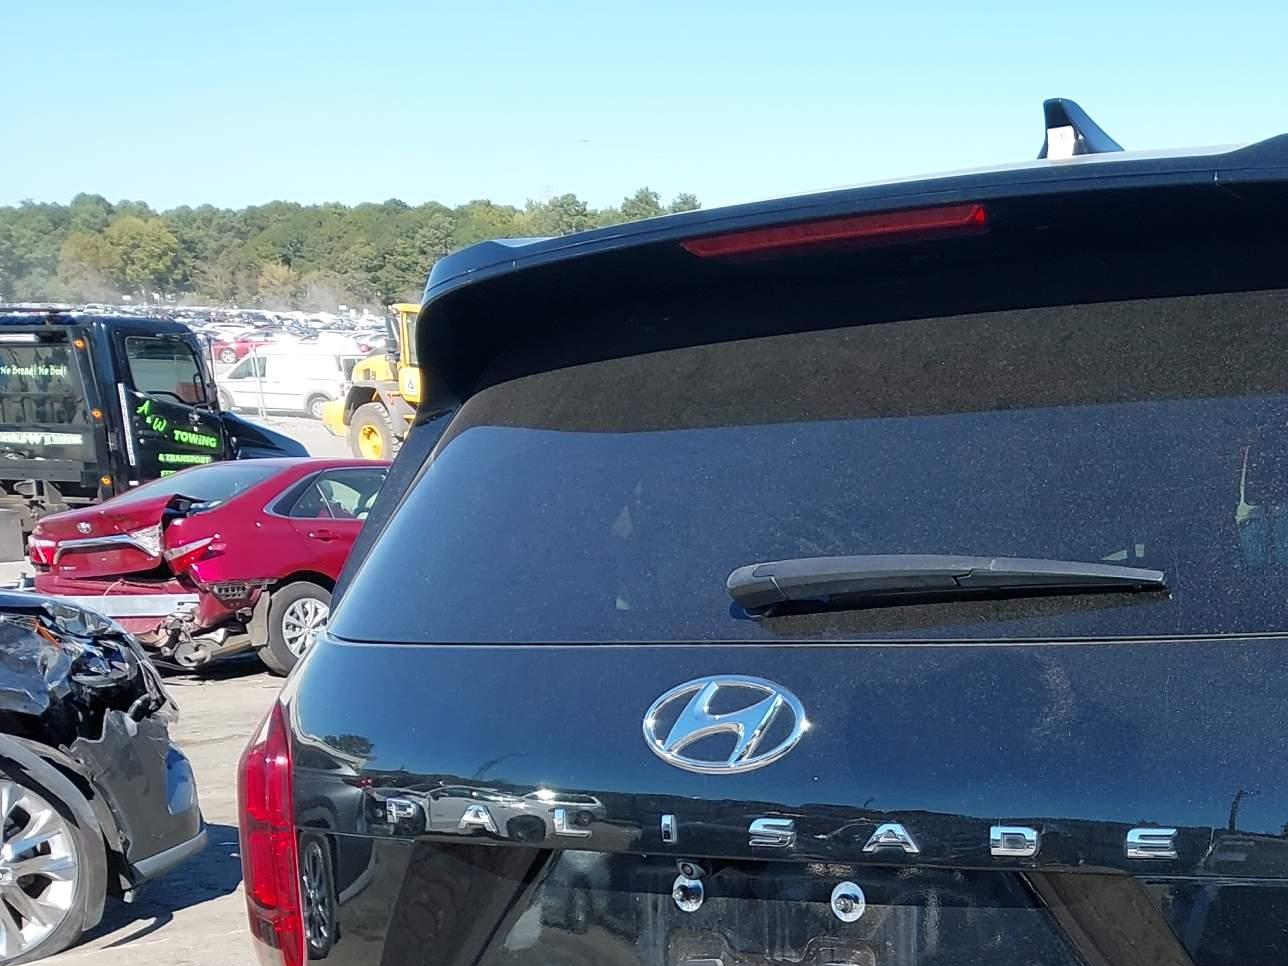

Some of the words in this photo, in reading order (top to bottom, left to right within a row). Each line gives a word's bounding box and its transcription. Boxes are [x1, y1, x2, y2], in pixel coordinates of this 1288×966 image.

[136, 400, 151, 415] A
[153, 417, 167, 431] W
[386, 798, 1177, 859] PALISADE
